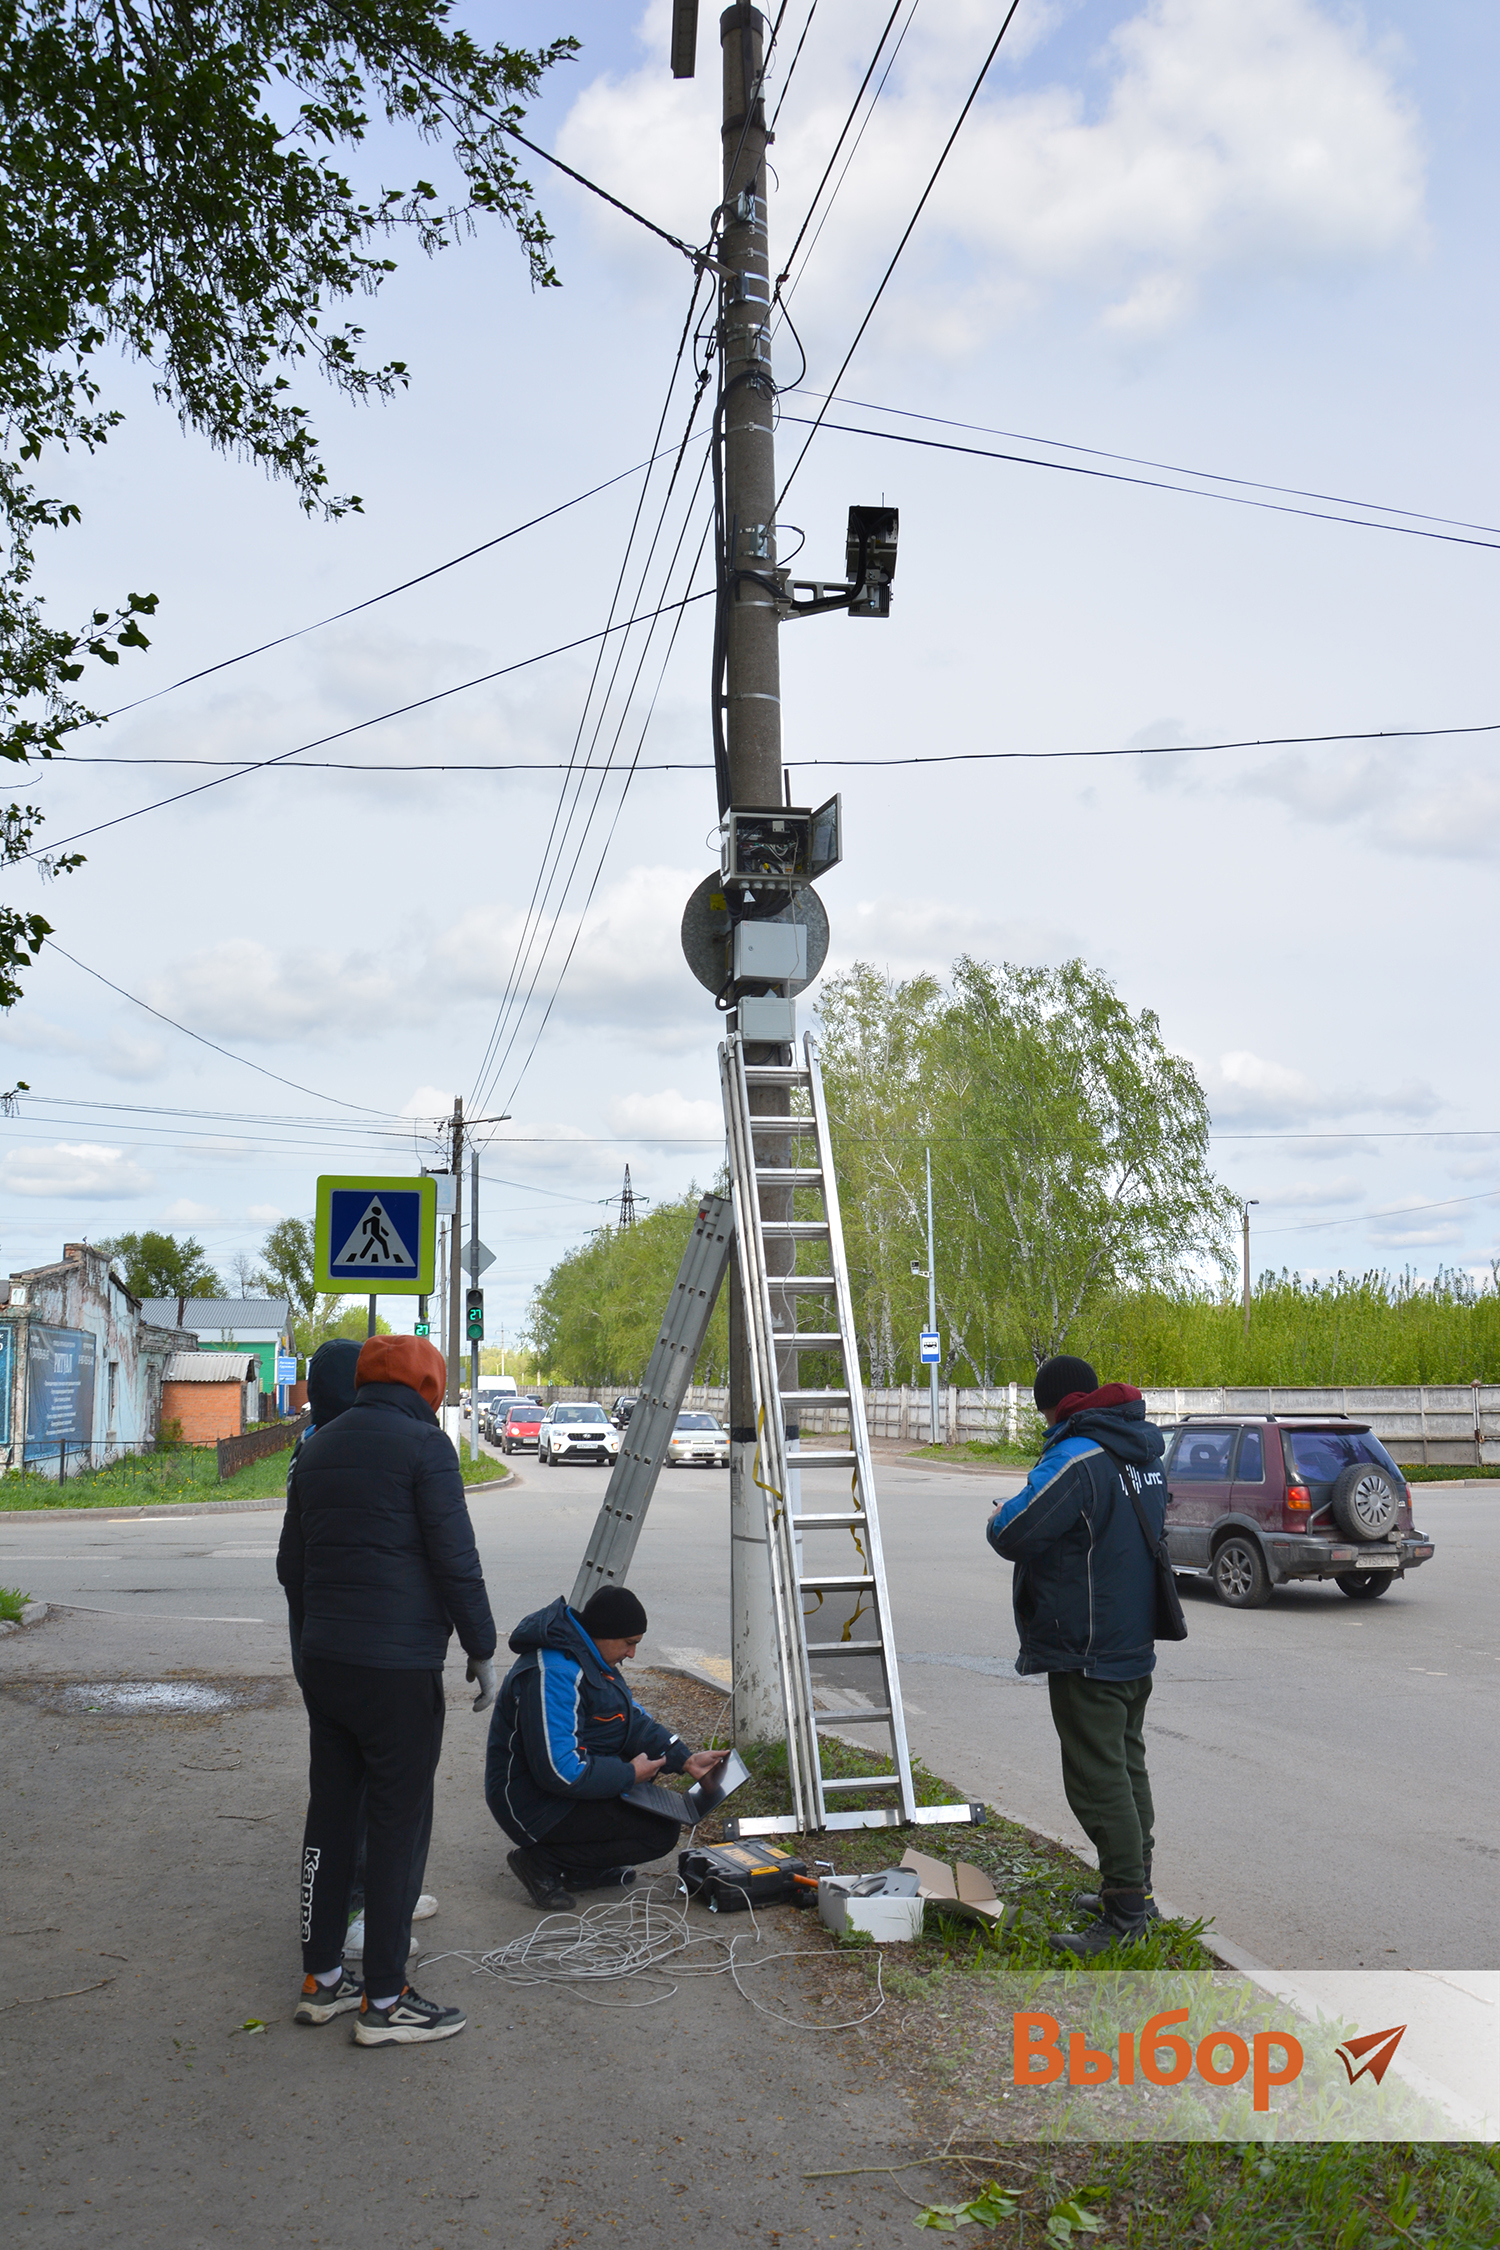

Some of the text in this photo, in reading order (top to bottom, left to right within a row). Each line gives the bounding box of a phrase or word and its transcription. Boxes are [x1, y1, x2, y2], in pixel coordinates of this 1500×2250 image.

[469, 1309, 482, 1321] 27
[415, 1324, 429, 1336] 27
[301, 1846, 321, 1942] Kappa
